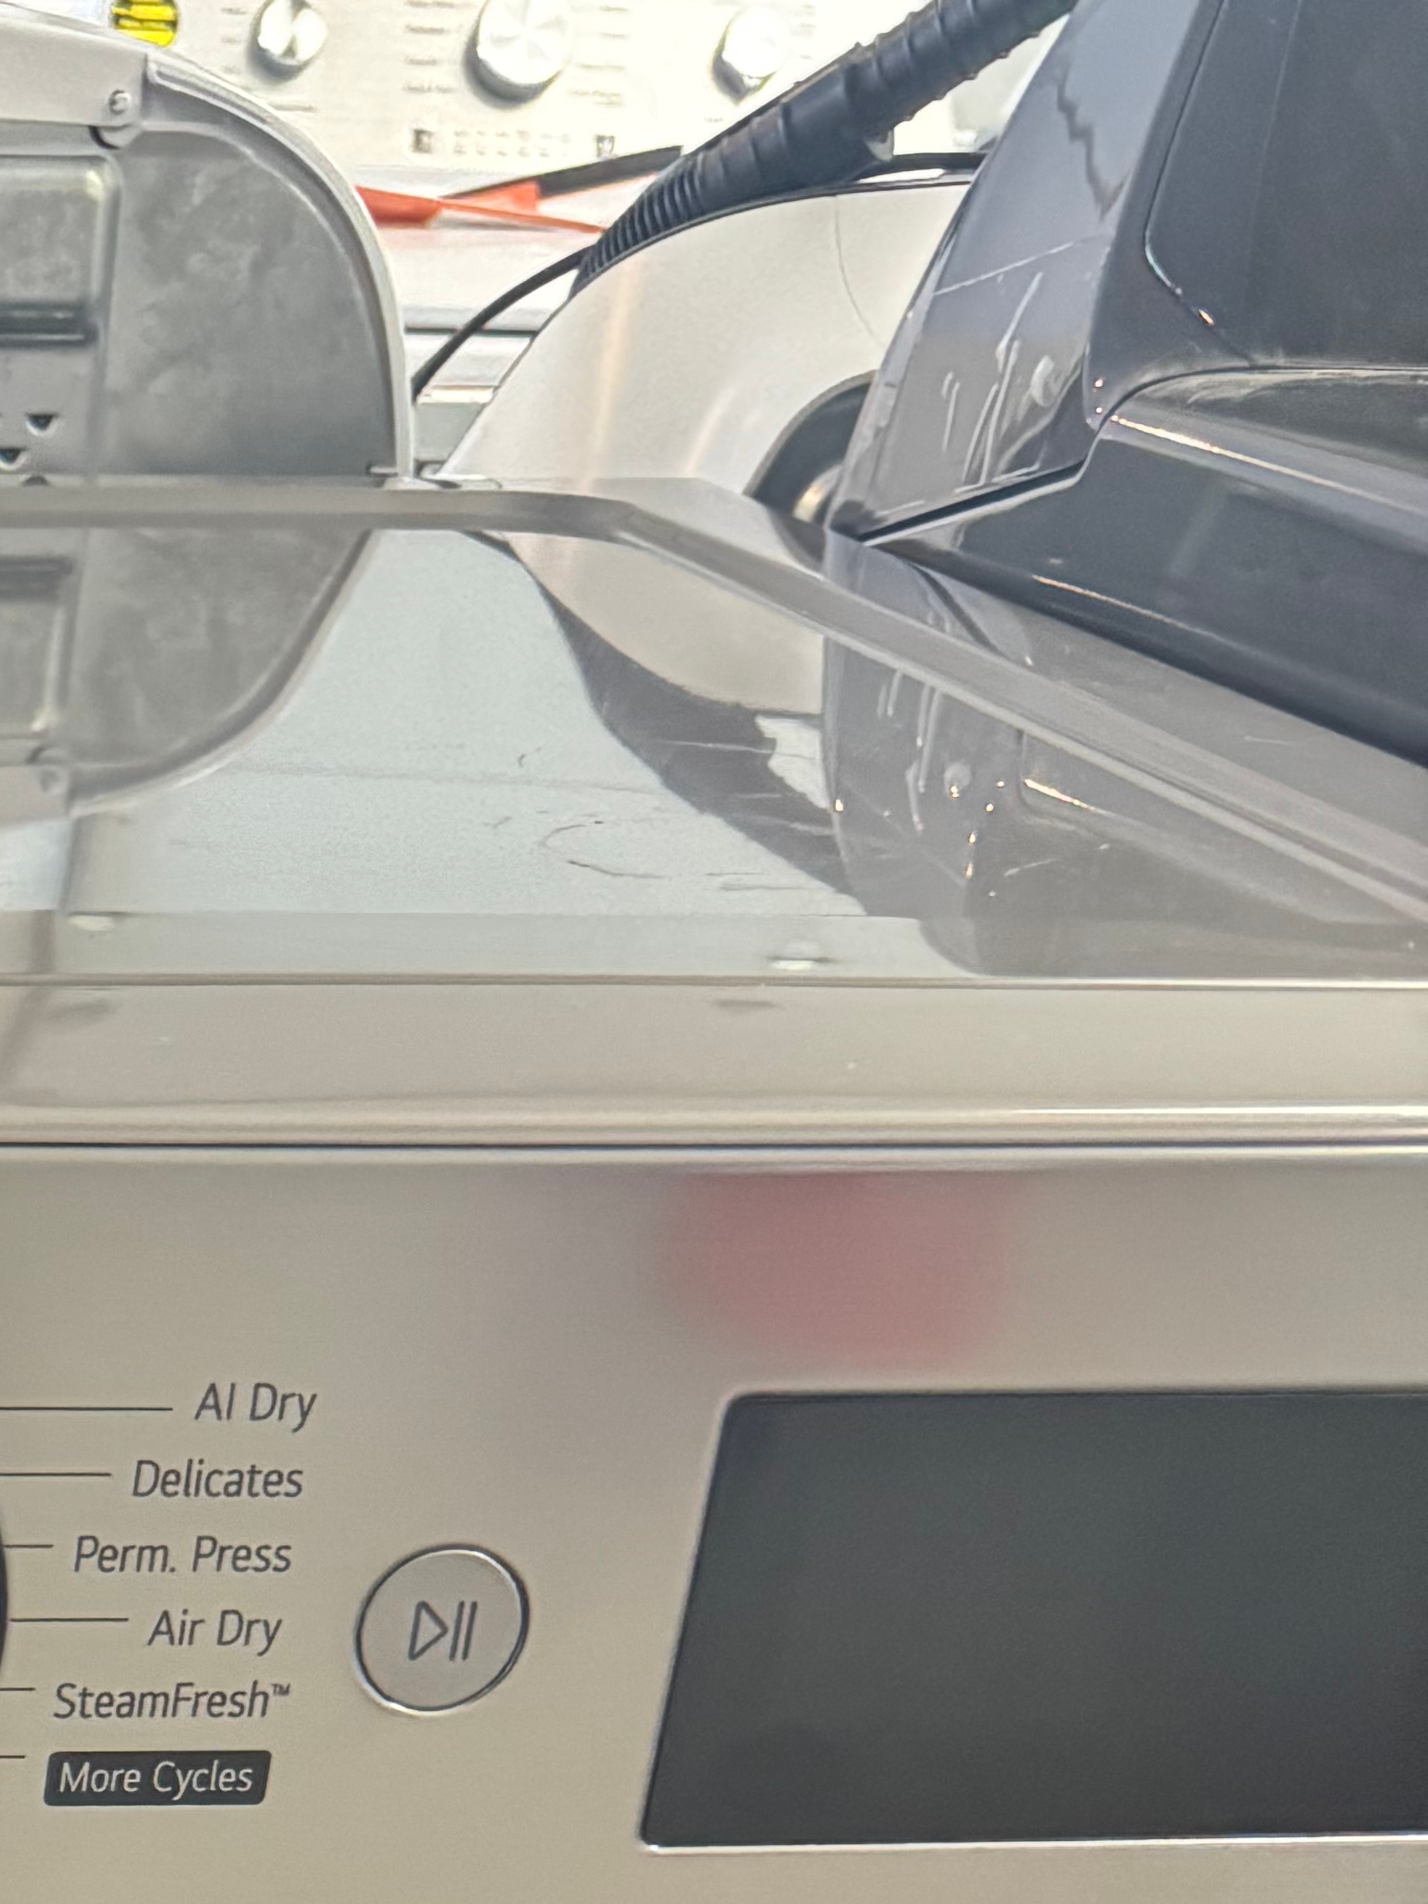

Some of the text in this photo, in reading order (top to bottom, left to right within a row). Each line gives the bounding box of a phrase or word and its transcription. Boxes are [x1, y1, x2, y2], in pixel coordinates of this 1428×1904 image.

[193, 1382, 317, 1433] AI Dry
[131, 1459, 303, 1499] Delicates
[73, 1534, 292, 1573] Perm. Press
[146, 1609, 283, 1655] Air Dry
[58, 1761, 253, 1801] More Cycles
